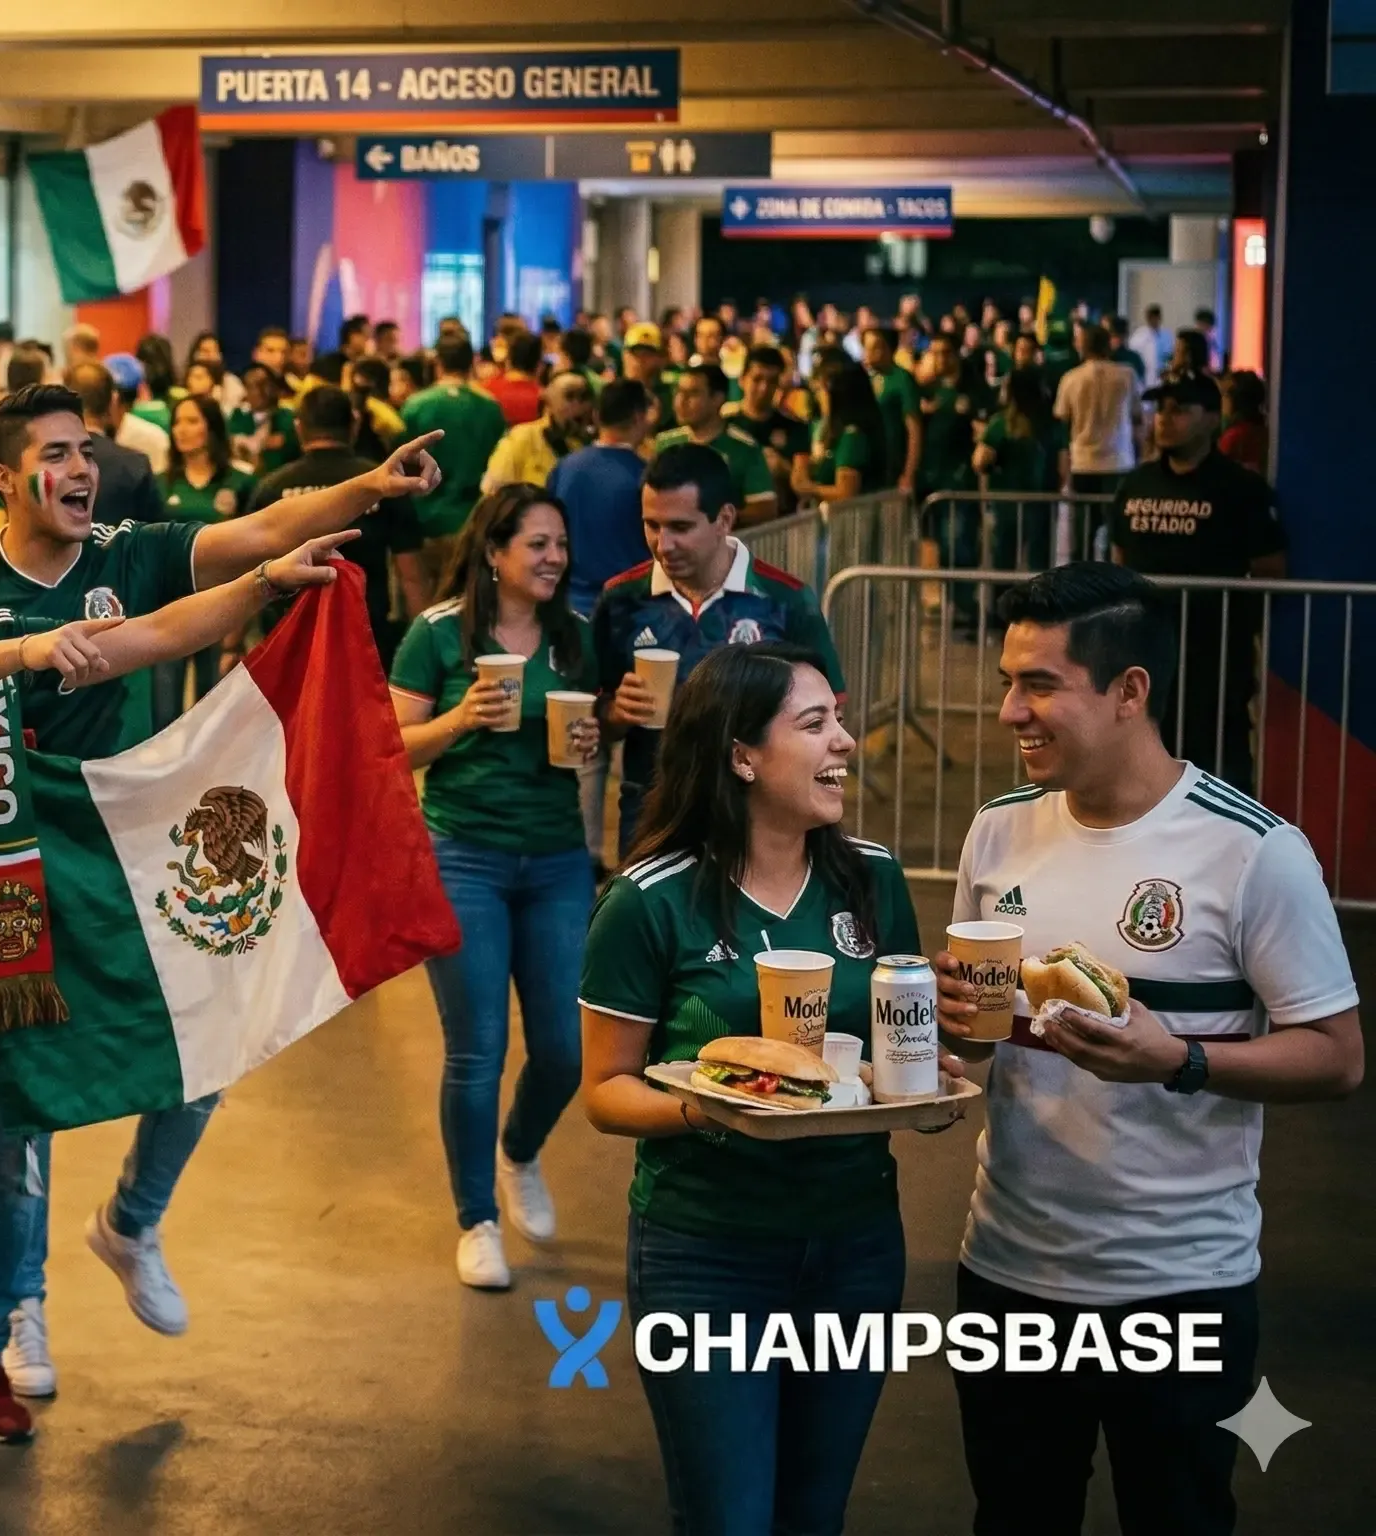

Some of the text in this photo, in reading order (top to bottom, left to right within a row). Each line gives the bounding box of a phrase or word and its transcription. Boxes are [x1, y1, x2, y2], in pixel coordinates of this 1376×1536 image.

[217, 69, 329, 102] PUERTA
[336, 68, 371, 100] 14
[398, 67, 515, 100] ACCESO
[523, 66, 660, 98] GENERAL
[401, 142, 480, 172] BAÑOS
[1124, 499, 1213, 518] SEGURIDAD
[1131, 517, 1197, 535] ESTADIO
[959, 961, 1017, 986] Modelo
